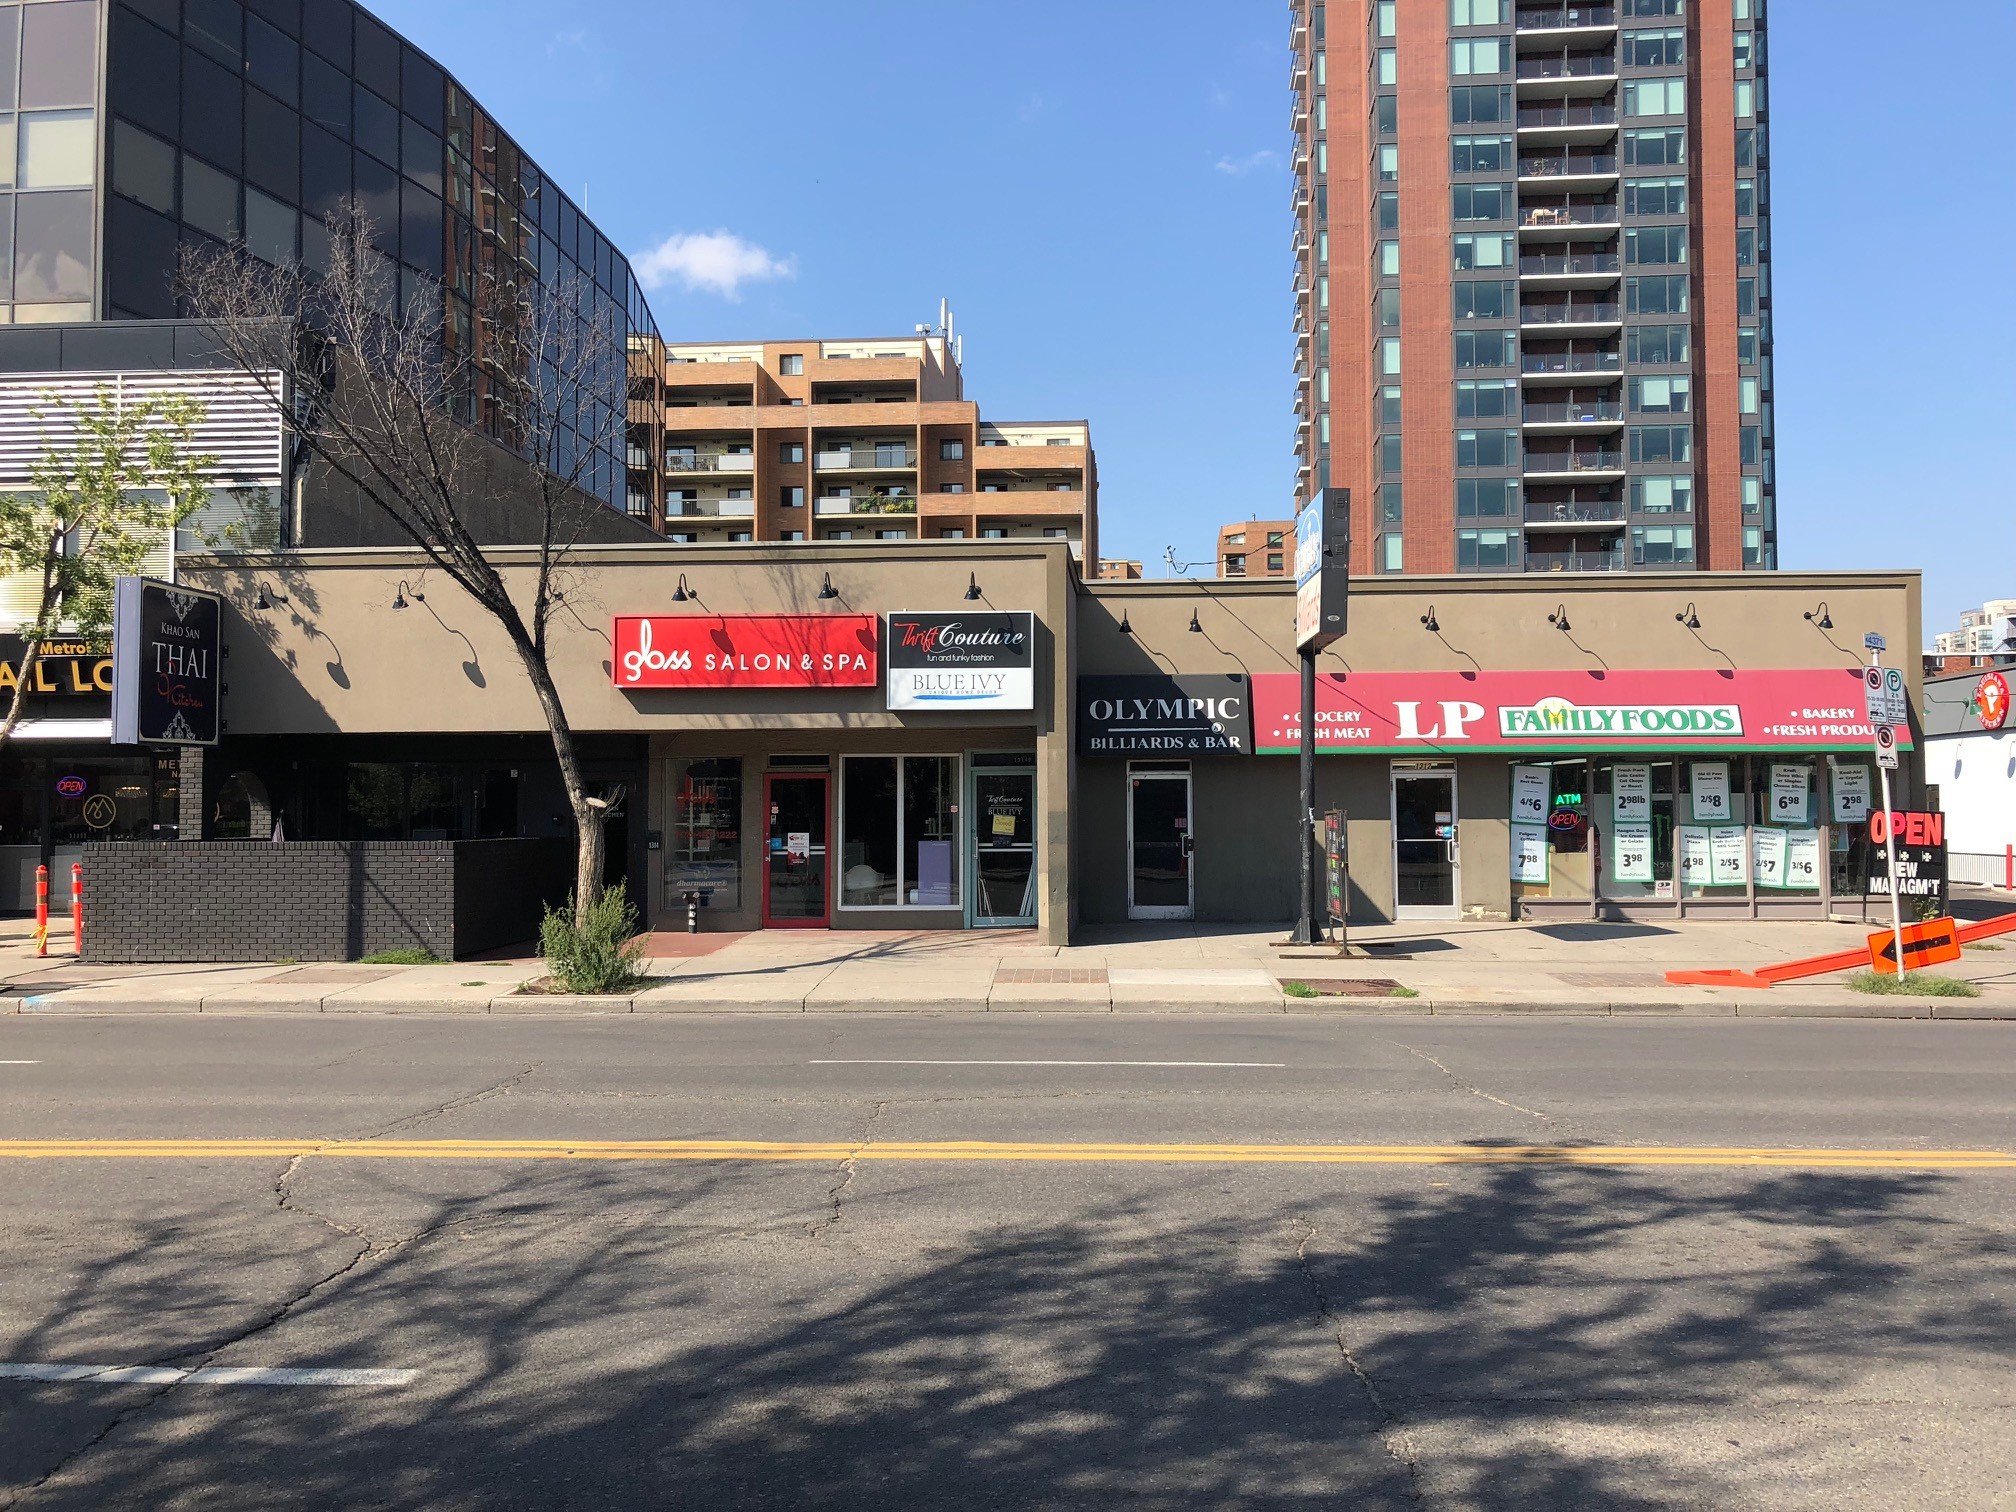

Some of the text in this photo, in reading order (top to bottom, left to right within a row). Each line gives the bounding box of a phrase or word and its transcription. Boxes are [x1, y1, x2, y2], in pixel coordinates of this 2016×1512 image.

[161, 622, 200, 639] KHAO SAN
[894, 622, 1027, 653] Thrift Couture
[624, 619, 867, 681] gloss SALON & SPA
[151, 642, 208, 679] THAI
[927, 654, 995, 663] fun and funky fashion
[913, 674, 1006, 690] BLUE IVY
[1089, 697, 1240, 721] OLYMPIC
[1802, 708, 1856, 719] BAKERY
[1392, 701, 1485, 739] LP
[1287, 727, 1372, 739] FRSH MEAT
[1772, 725, 1875, 736] FRESH PRODU
[1090, 736, 1242, 750] BILLIARDS & BAR
[58, 781, 84, 792] OPEN
[1520, 797, 1542, 811] 4/$6
[1555, 793, 1582, 805] ATM
[1700, 794, 1722, 808] 2/$8
[1550, 813, 1578, 825] OPEN
[1870, 811, 1942, 846] OPEN
[1720, 858, 1740, 871] 2/$5
[1755, 859, 1776, 873] 2/$7
[1791, 861, 1813, 874] 3/$6
